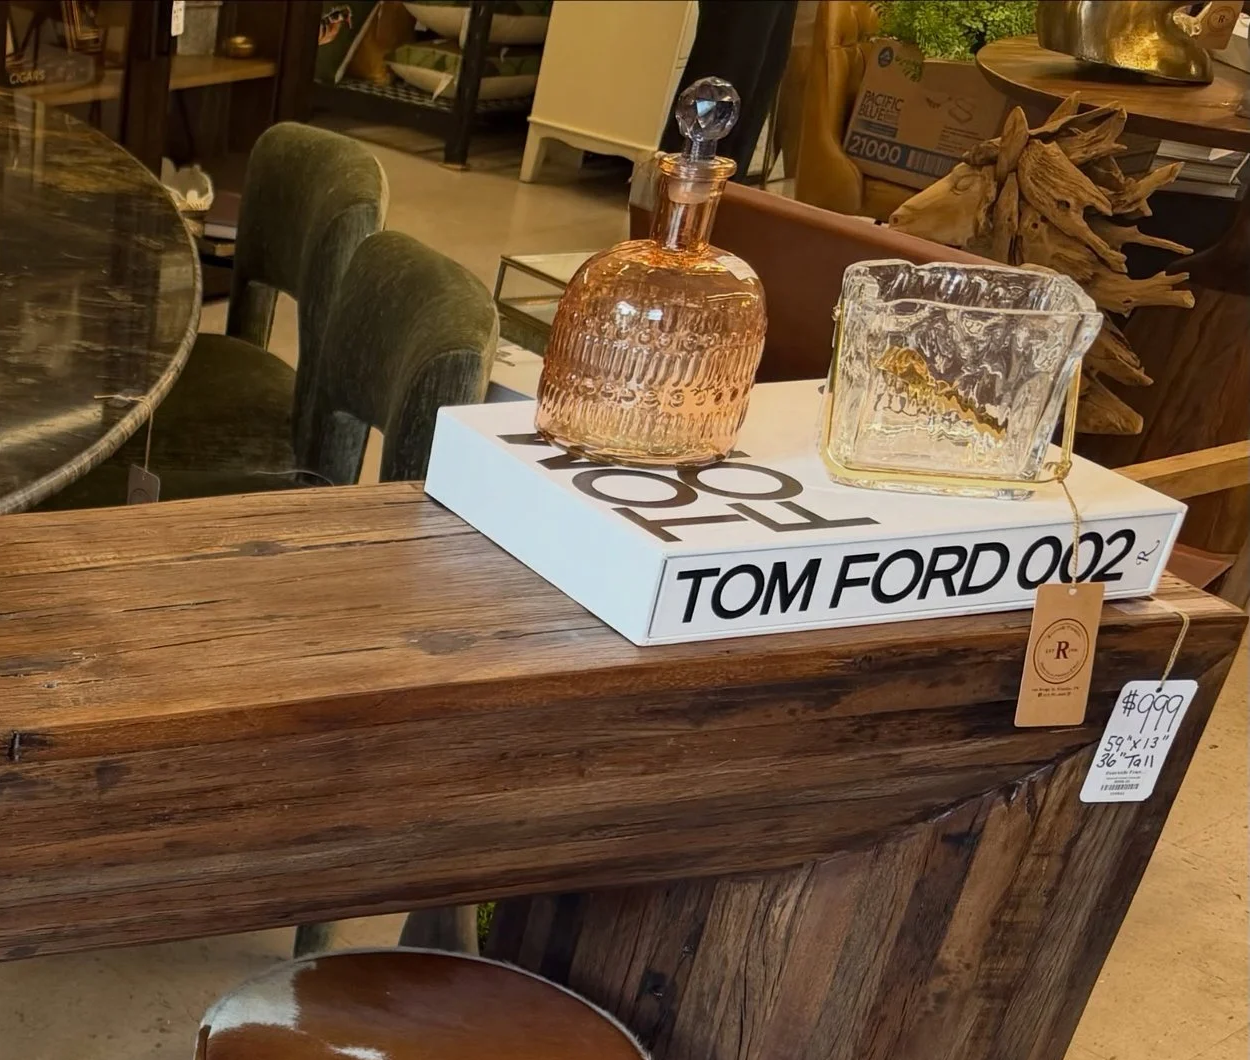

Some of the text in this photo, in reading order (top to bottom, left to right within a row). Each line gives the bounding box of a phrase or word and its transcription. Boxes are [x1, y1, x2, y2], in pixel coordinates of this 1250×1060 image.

[858, 103, 885, 121] BLUE
[861, 90, 904, 112] PACIFIC
[849, 135, 901, 164] 21000
[676, 529, 1137, 623] TOM FORD 002
[1054, 640, 1070, 660] R
[1122, 689, 1184, 734] $999
